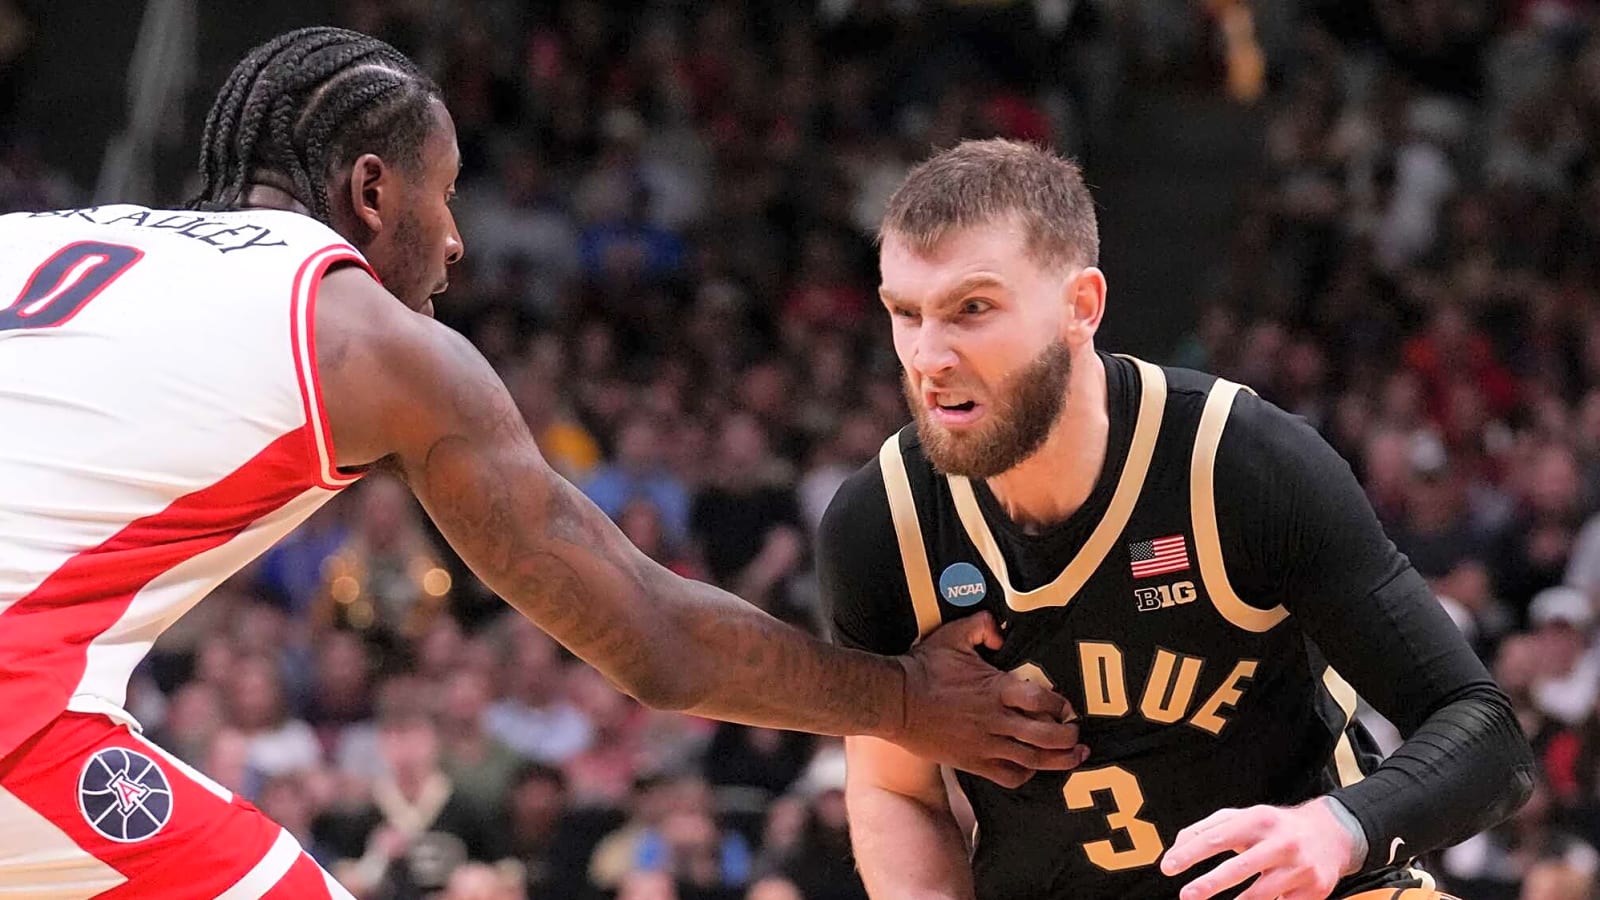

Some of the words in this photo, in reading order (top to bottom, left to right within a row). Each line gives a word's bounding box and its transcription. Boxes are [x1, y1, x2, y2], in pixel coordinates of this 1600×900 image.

[0, 240, 146, 331] 0
[947, 582, 984, 599] NCAA
[1003, 639, 1259, 737] DUE
[1062, 765, 1165, 872] 3
